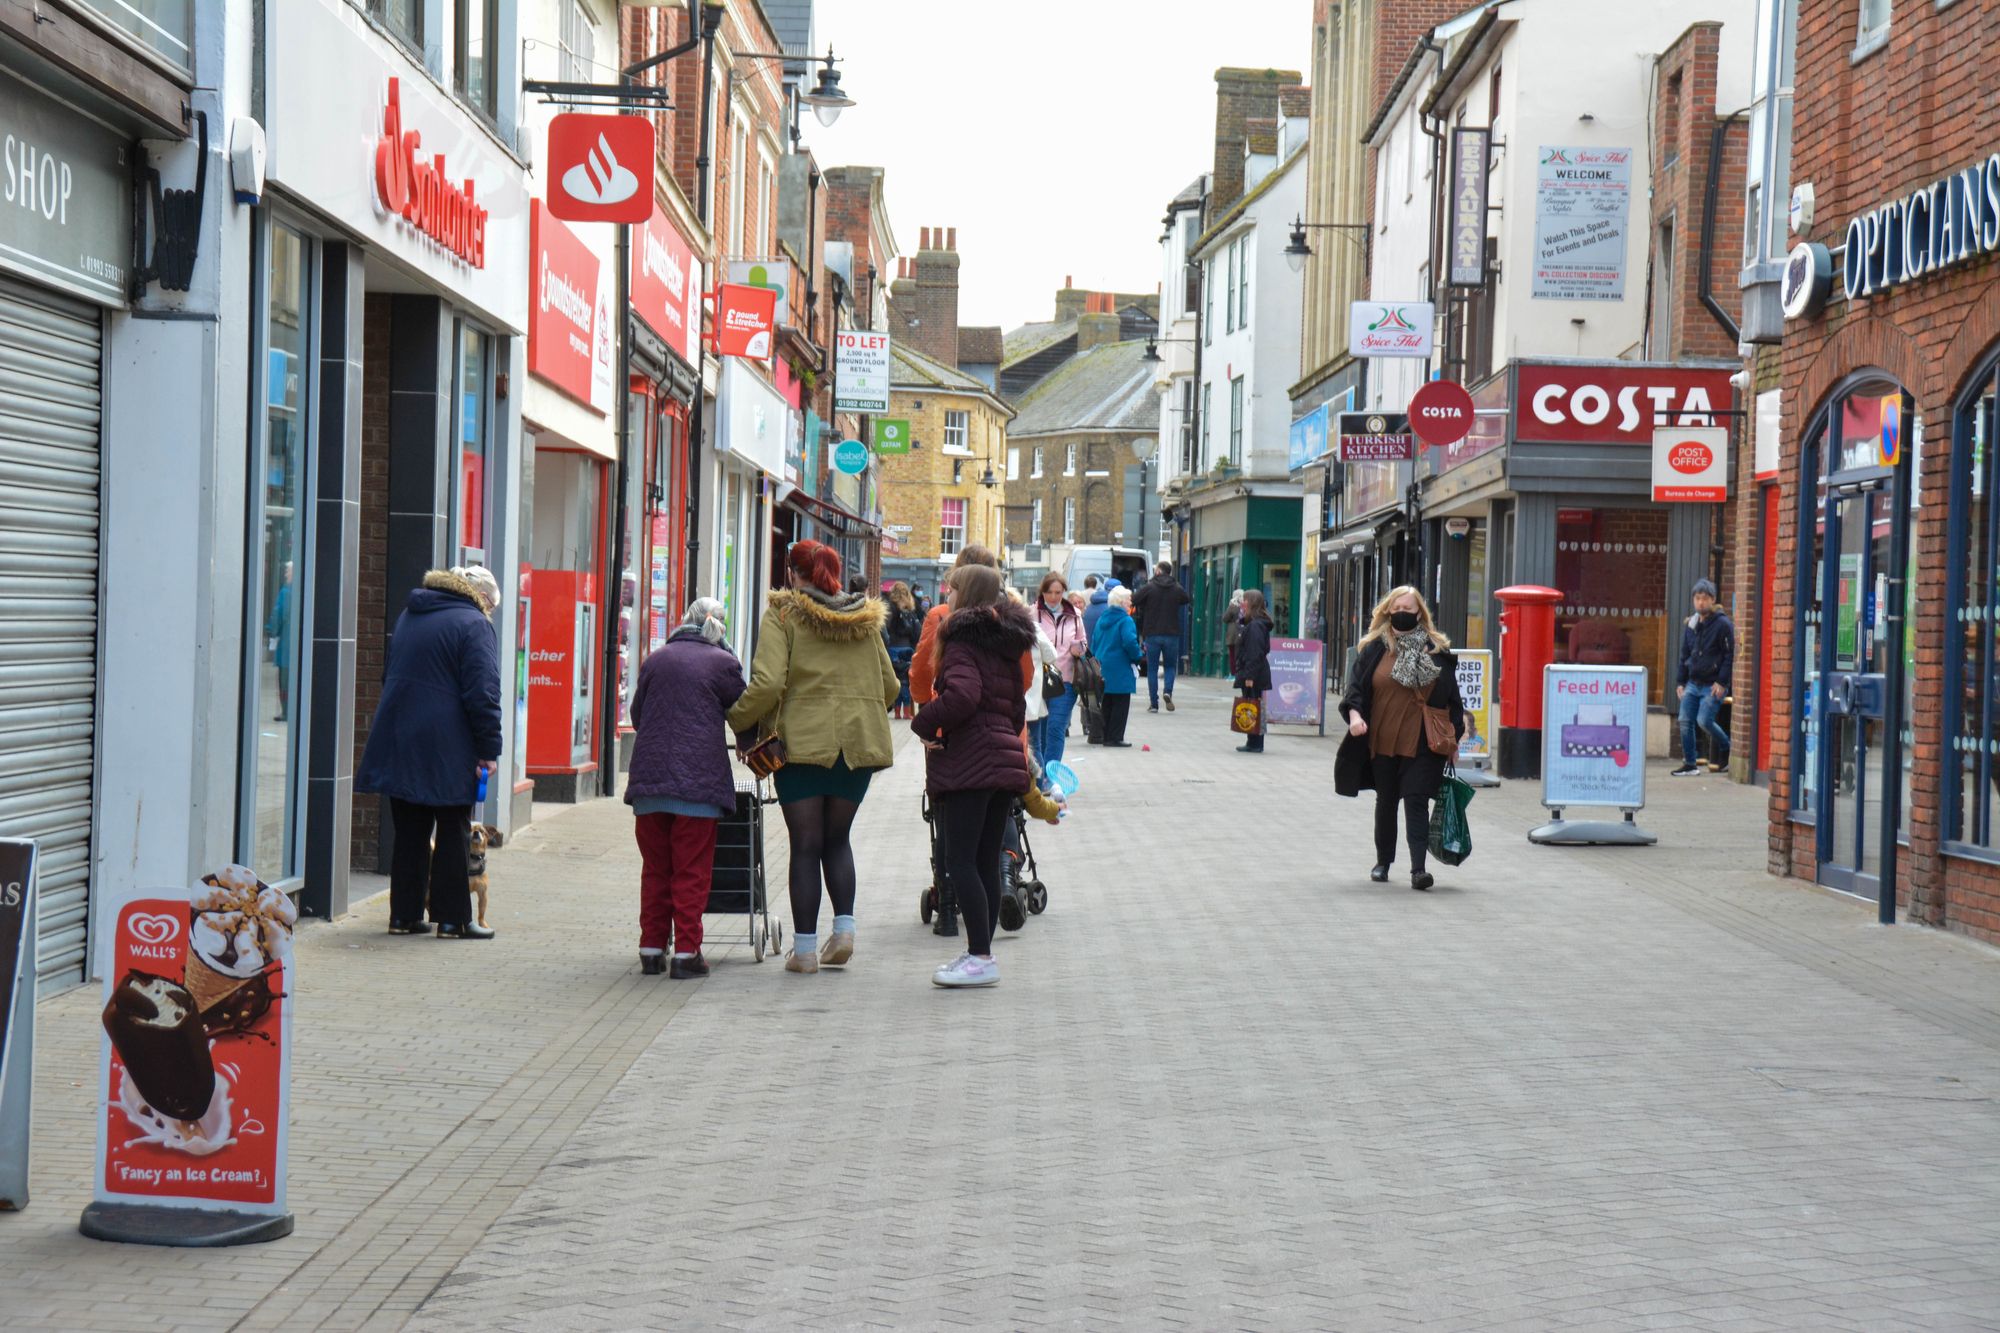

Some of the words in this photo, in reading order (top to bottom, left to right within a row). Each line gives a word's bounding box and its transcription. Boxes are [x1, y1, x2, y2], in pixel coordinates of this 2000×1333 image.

[5, 134, 72, 225] SHOP
[1556, 169, 1613, 180] WELCOME
[402, 129, 488, 270] Santander
[1457, 132, 1481, 268] RESTAURANT
[1544, 232, 1568, 246] Watch
[1569, 227, 1585, 238] This
[1586, 219, 1610, 233] Space
[1843, 153, 2000, 300] OPTICIANS
[1541, 250, 1554, 259] For
[1555, 241, 1581, 255] Events
[1582, 236, 1596, 247] and
[1597, 229, 1619, 242] Deals
[735, 311, 759, 321] pound
[734, 318, 768, 329] stretcher
[837, 335, 855, 348] TO
[860, 336, 887, 349] LET
[1361, 333, 1391, 349] Spice
[1394, 334, 1423, 347] Hut
[838, 400, 858, 408] 01992
[1532, 384, 1717, 432] COSTA
[1422, 406, 1462, 419] COSTA
[1347, 435, 1405, 445] TURKISH
[1346, 444, 1406, 455] KITCHEN
[1678, 447, 1705, 457] POST
[1672, 457, 1708, 467] OFFICE
[1694, 490, 1716, 499] Change
[528, 649, 565, 662] cher
[1457, 672, 1482, 683] AST
[1466, 684, 1482, 695] OF
[1557, 679, 1600, 695] Feed
[1604, 680, 1637, 695] Me!
[130, 944, 177, 959] WALL'S
[120, 1166, 162, 1186] Fancy
[165, 1168, 182, 1181] an
[186, 1167, 207, 1181] Ice
[210, 1167, 260, 1183] Cream?
